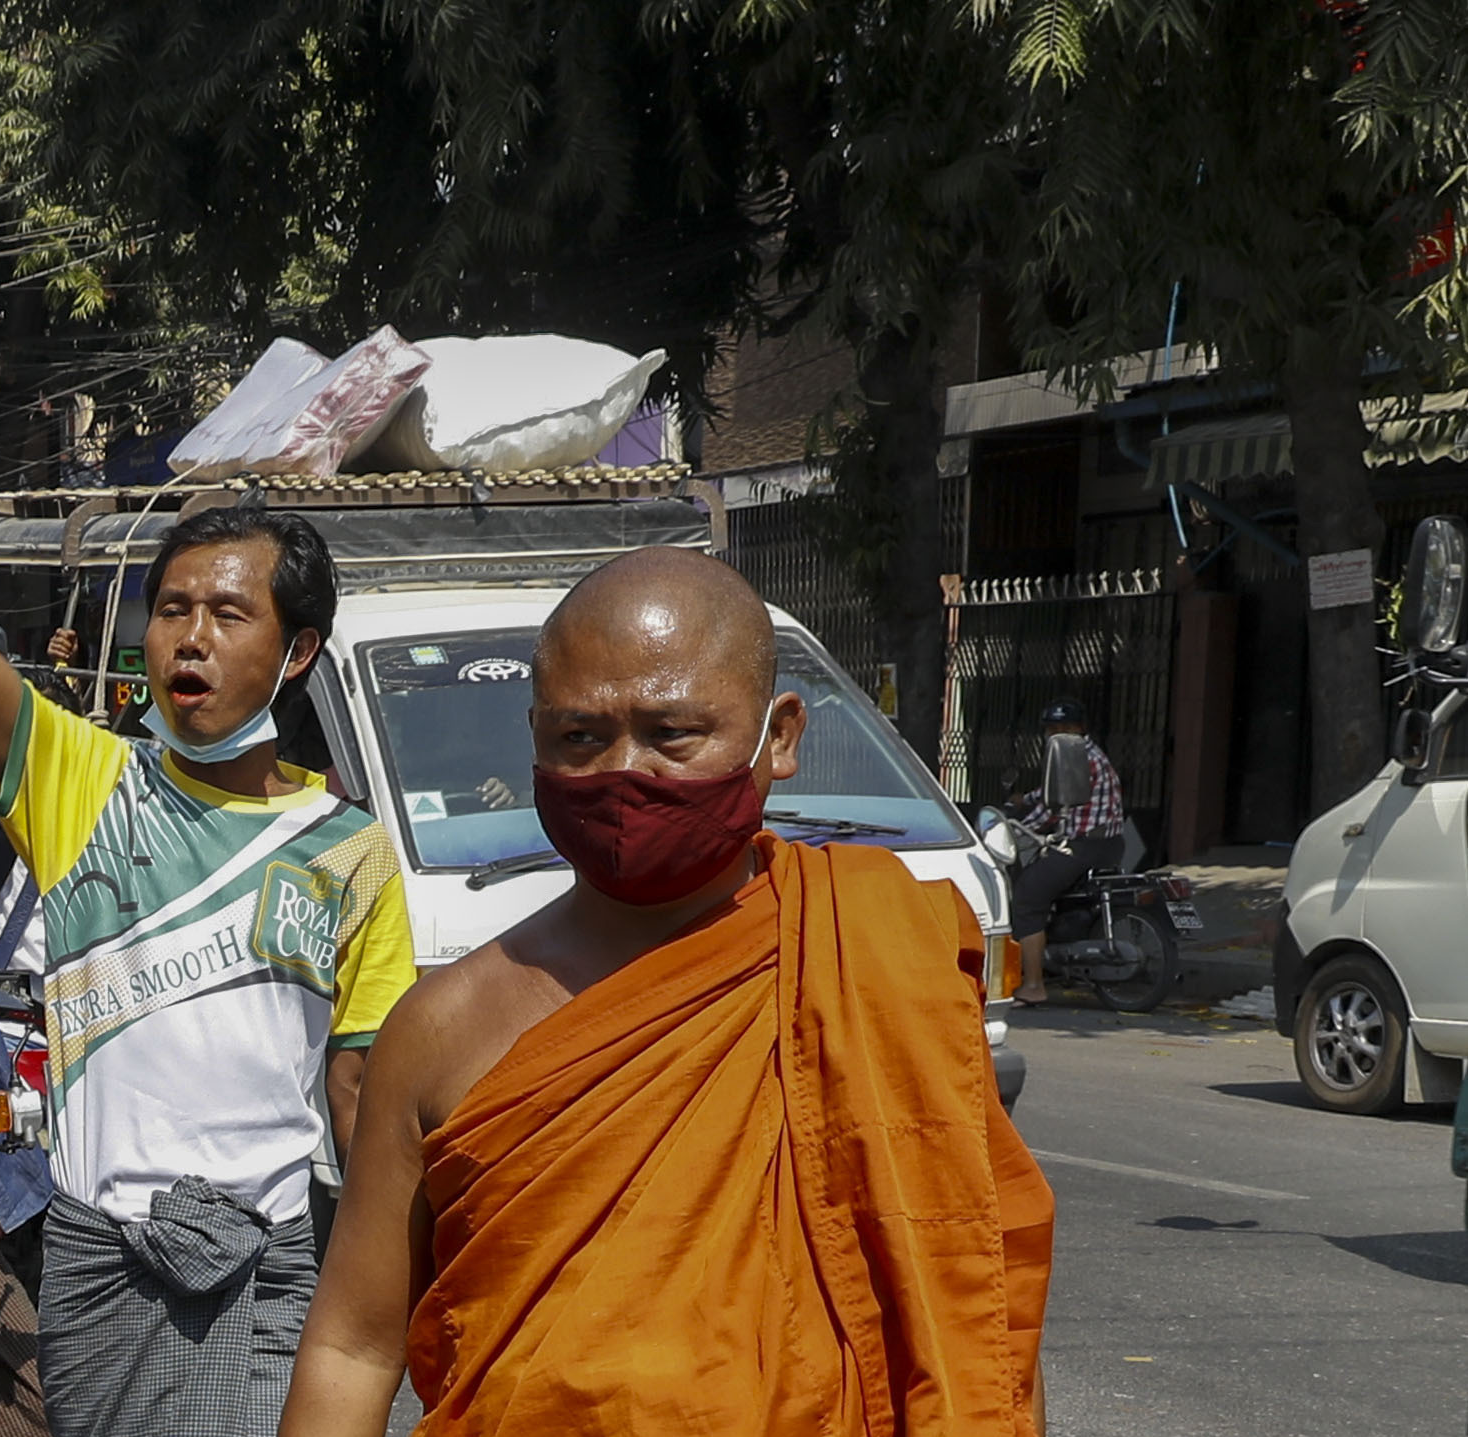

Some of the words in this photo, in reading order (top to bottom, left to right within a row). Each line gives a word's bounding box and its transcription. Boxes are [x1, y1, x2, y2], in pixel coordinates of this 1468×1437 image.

[51, 983, 123, 1037] EXTRA
[128, 924, 246, 1005] SMOOTH
[276, 917, 336, 970] CLUB
